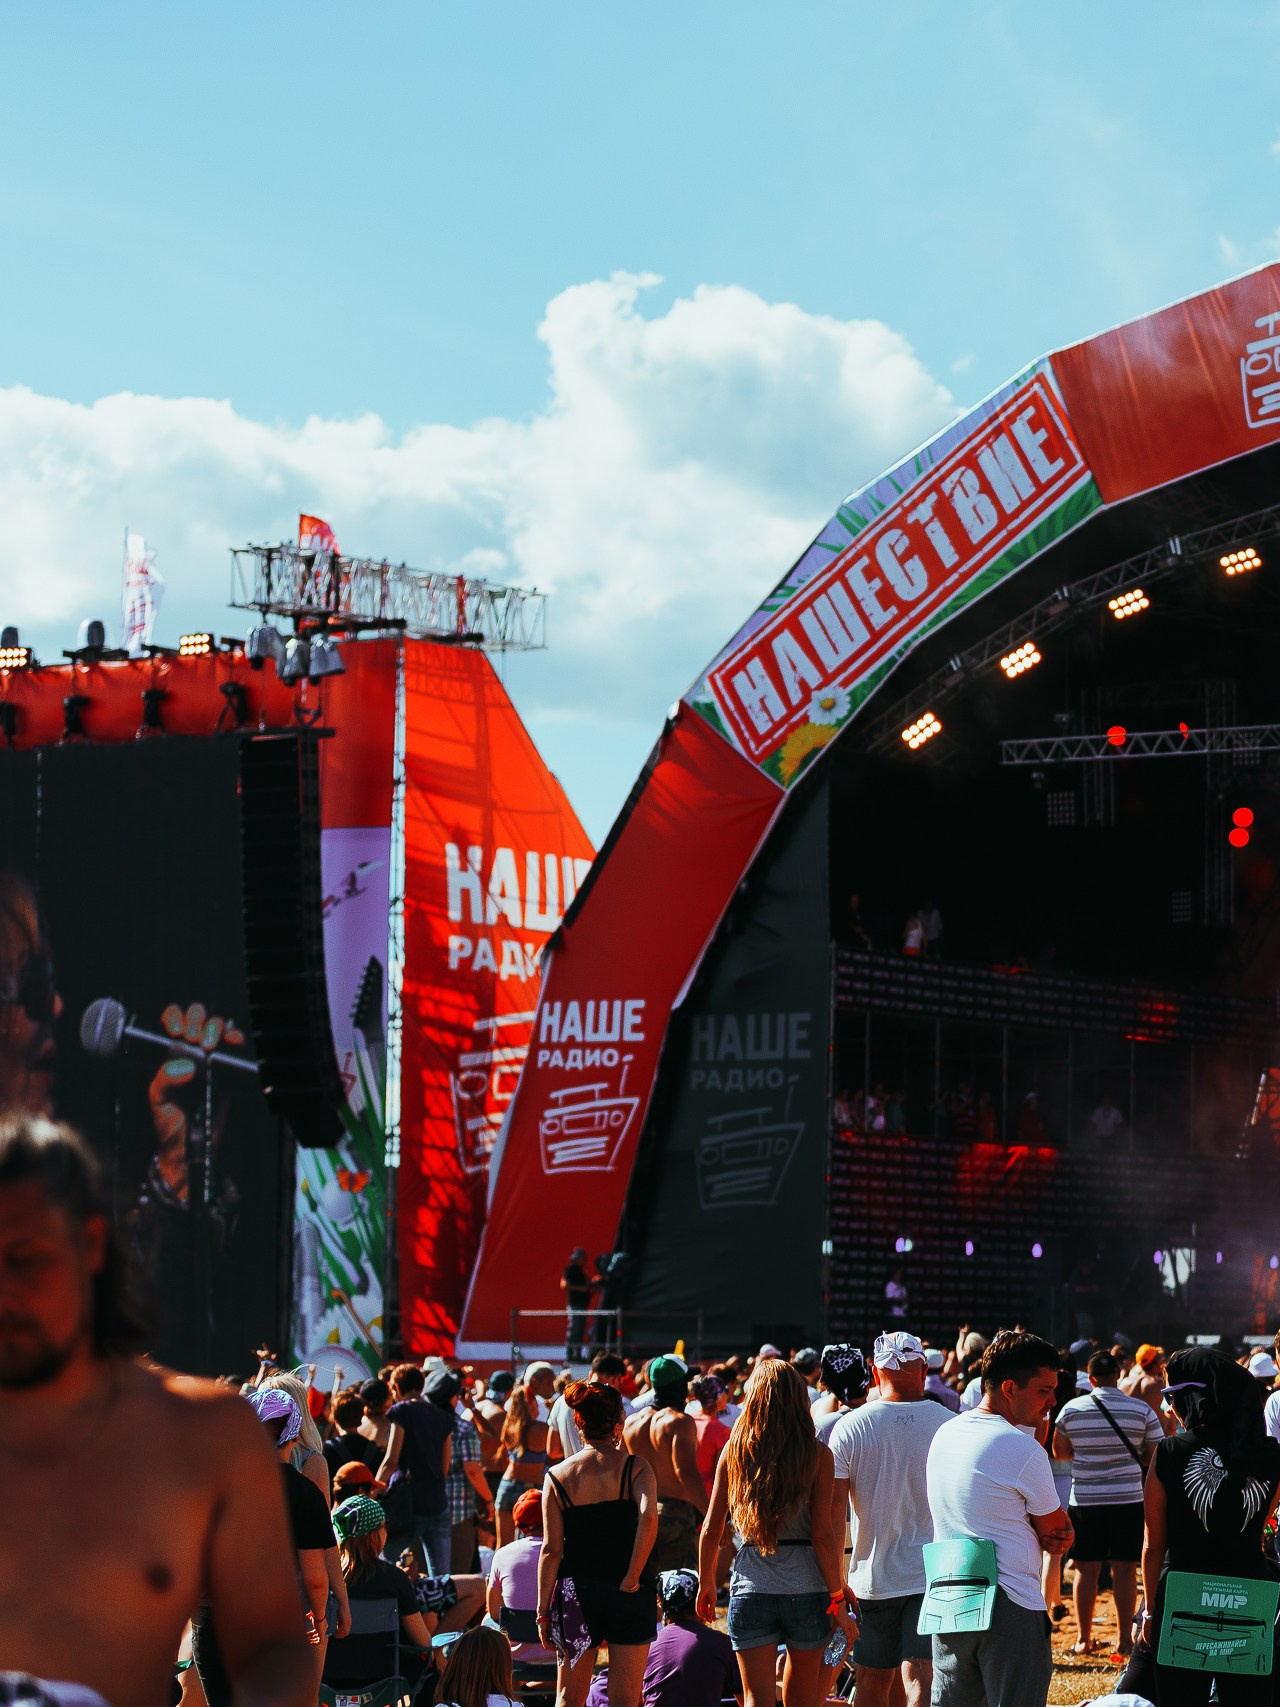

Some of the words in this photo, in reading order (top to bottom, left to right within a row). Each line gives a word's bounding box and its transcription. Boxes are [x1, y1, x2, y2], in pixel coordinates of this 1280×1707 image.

[731, 407, 1065, 736] НАШЕСТВИЕ
[538, 999, 646, 1043] НАШЕ
[692, 1012, 812, 1061] НАШЕ
[536, 1047, 619, 1070] РАДИО
[690, 1068, 785, 1093] РАДИО
[1201, 1592, 1248, 1609] МИР
[1195, 1639, 1247, 1650] ПЕРЕСАЖИВАЙСЯ
[1208, 1649, 1218, 1657] НА
[1218, 1648, 1234, 1656] МИР
